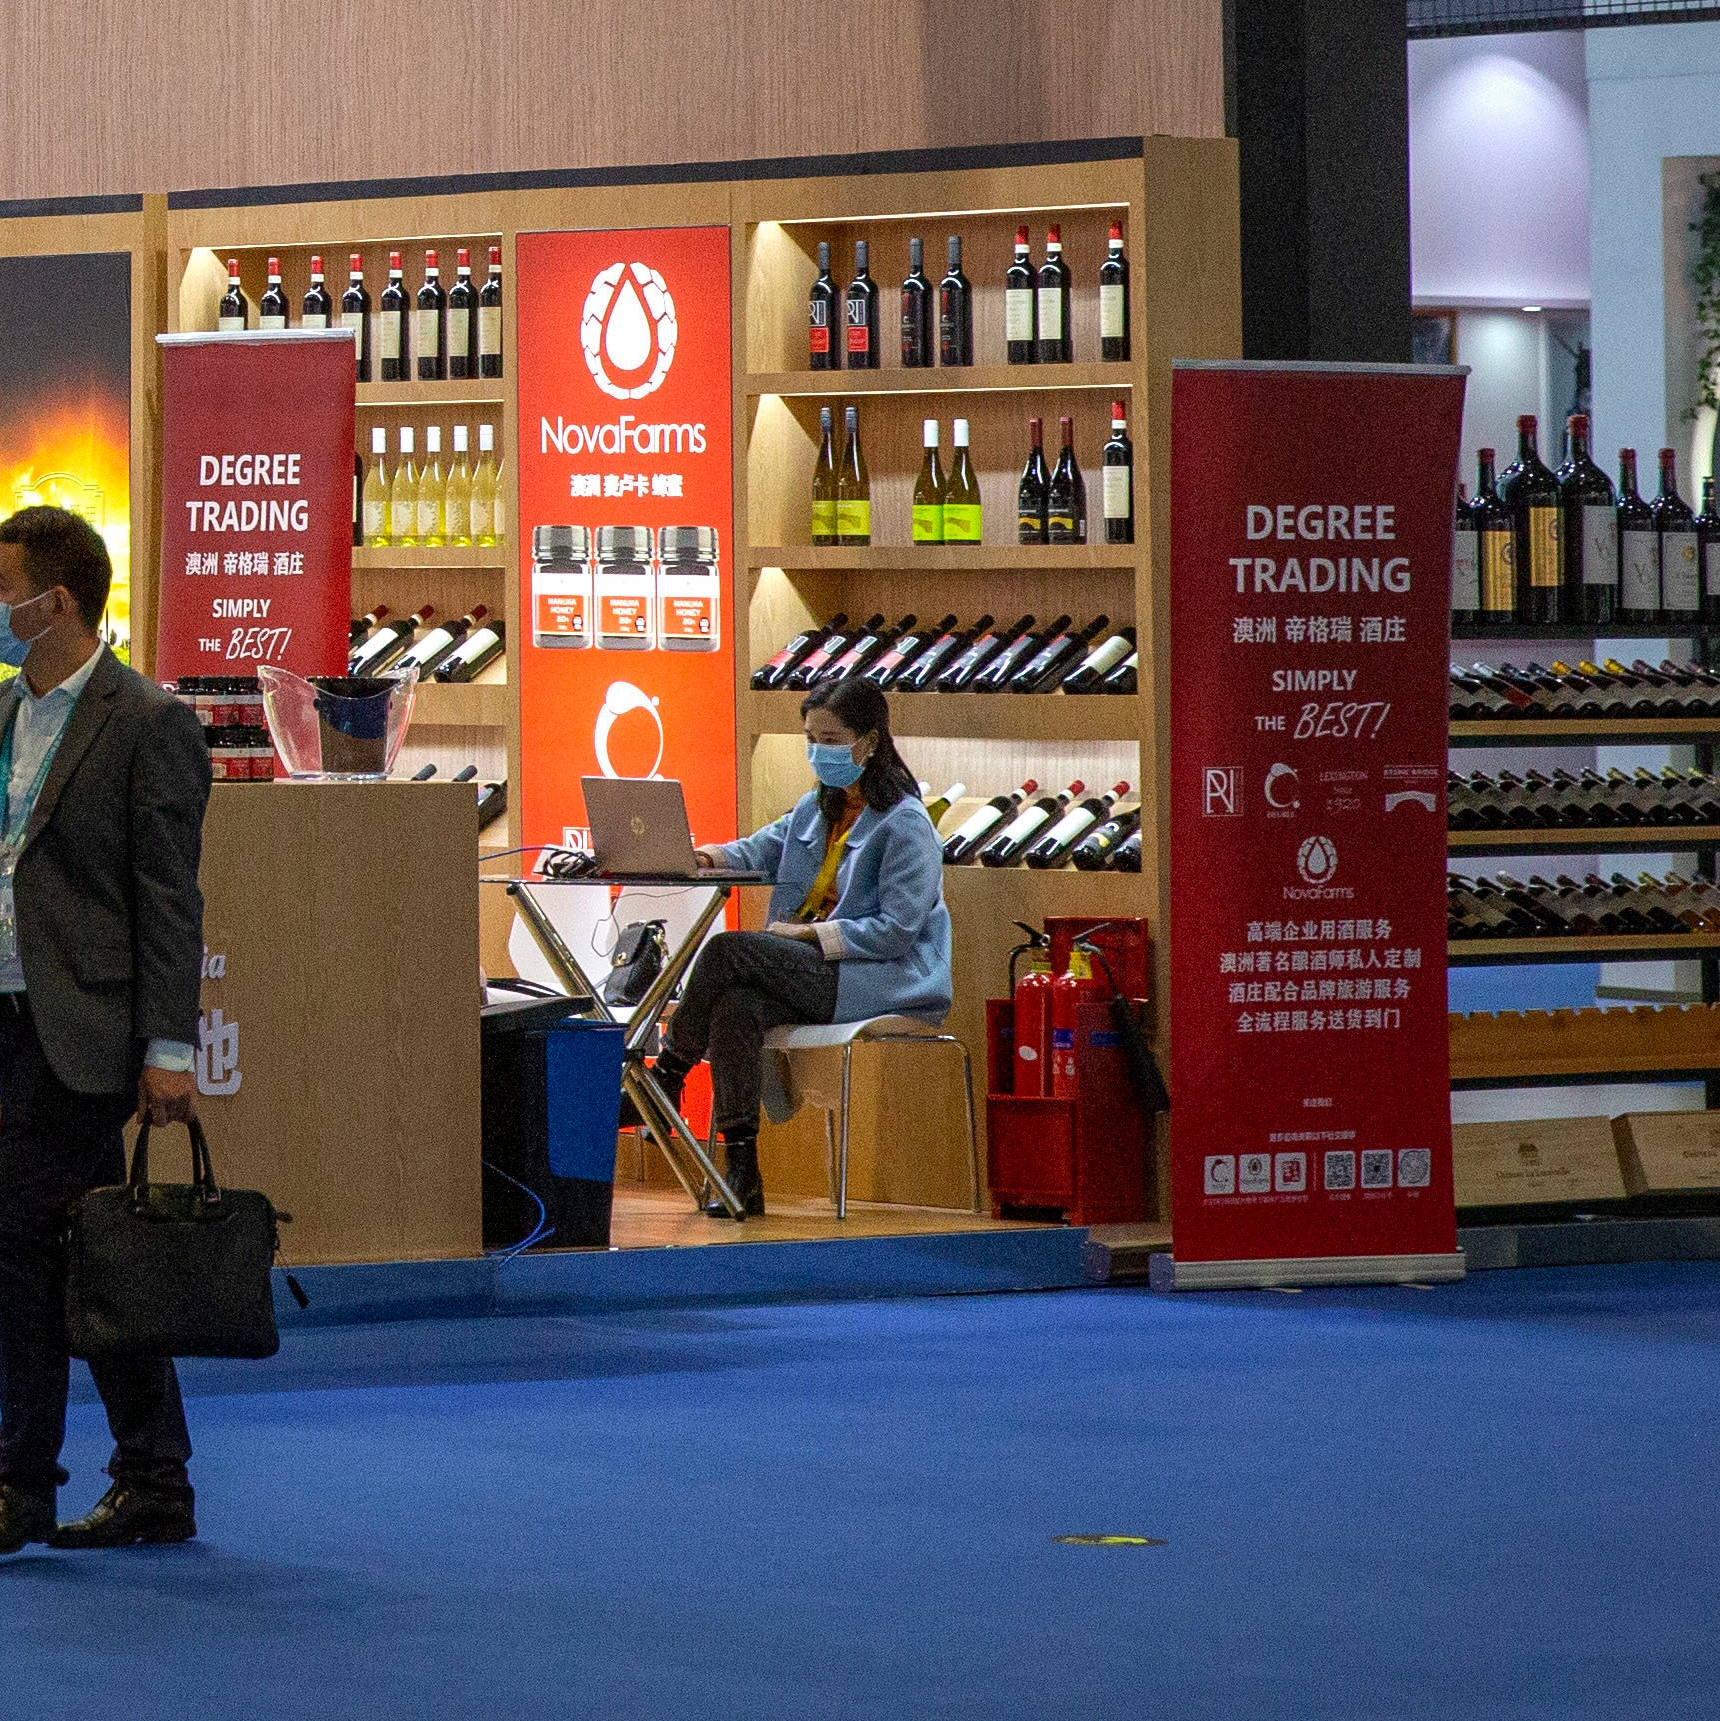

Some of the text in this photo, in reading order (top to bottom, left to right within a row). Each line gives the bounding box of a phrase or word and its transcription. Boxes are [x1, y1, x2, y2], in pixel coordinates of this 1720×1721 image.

[540, 414, 708, 455] NovaFarms
[199, 453, 302, 488] DEGREE
[185, 499, 310, 533] TRADING
[1245, 503, 1397, 542] DEGREE
[185, 550, 305, 577] 澳洲 帝格瑞 酒庄
[1229, 556, 1412, 595] TRADING
[211, 597, 272, 621] SIMPLY
[198, 626, 293, 662] THE BEST!
[1232, 615, 1407, 644] 澳洲 帝格瑞 酒庄
[1272, 669, 1358, 694] SIMPLY
[1254, 702, 1392, 741] THE BEST!
[1282, 885, 1355, 901] NovaFarms
[1246, 918, 1393, 943] 高端企业用酒服务
[1236, 1008, 1402, 1033] 全流程服务送货到门
